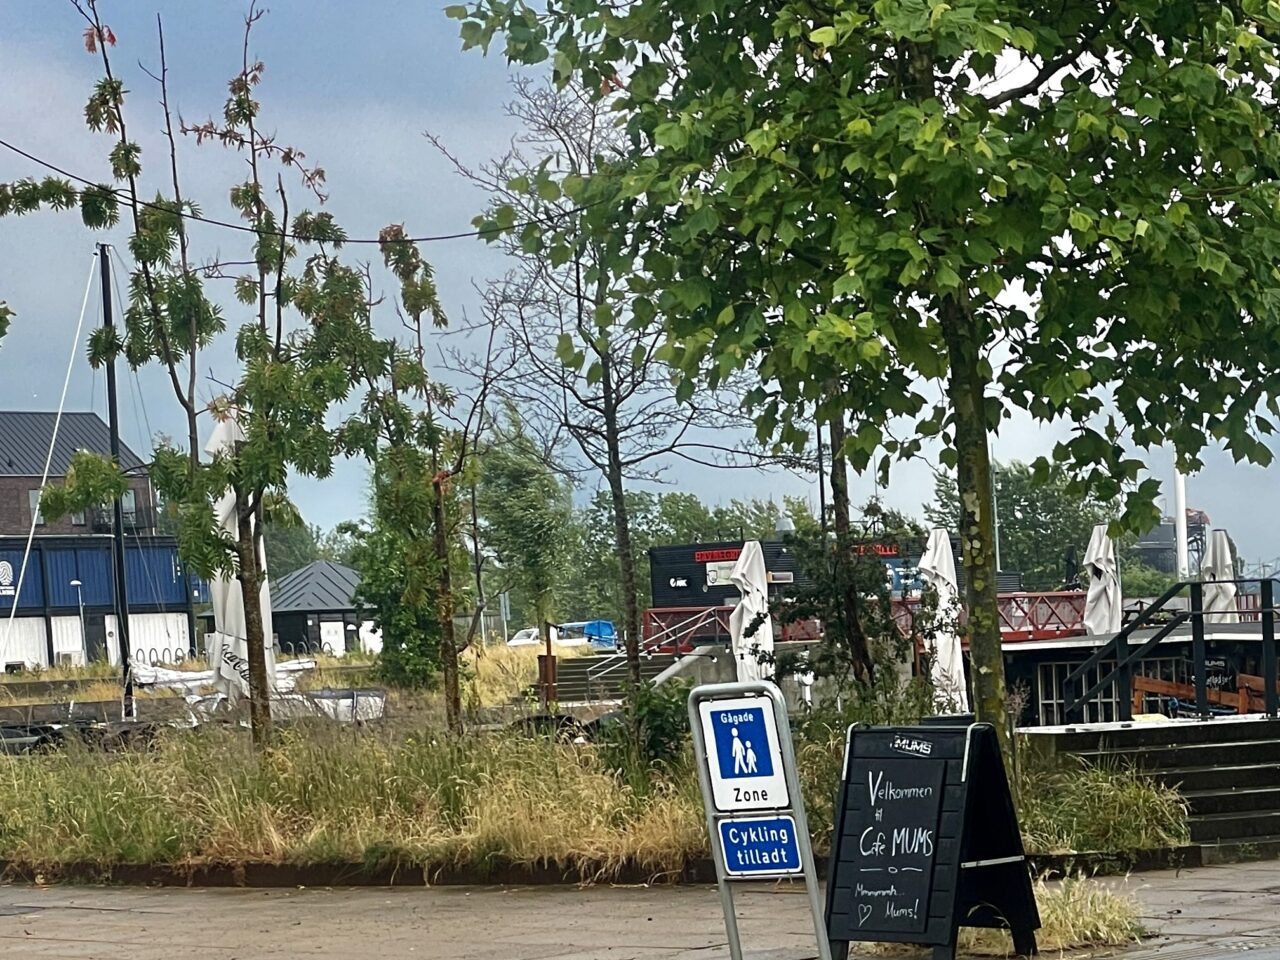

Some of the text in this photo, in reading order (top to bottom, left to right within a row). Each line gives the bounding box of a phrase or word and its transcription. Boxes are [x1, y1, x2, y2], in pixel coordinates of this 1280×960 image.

[720, 711, 754, 725] Gågade
[894, 738, 932, 755] MUMS
[733, 787, 769, 803] Zone
[868, 770, 933, 807] Velkommen
[729, 827, 789, 847] Cykling
[891, 827, 934, 857] MUMS
[737, 848, 788, 865] tilladt
[884, 898, 919, 919] Mums!
